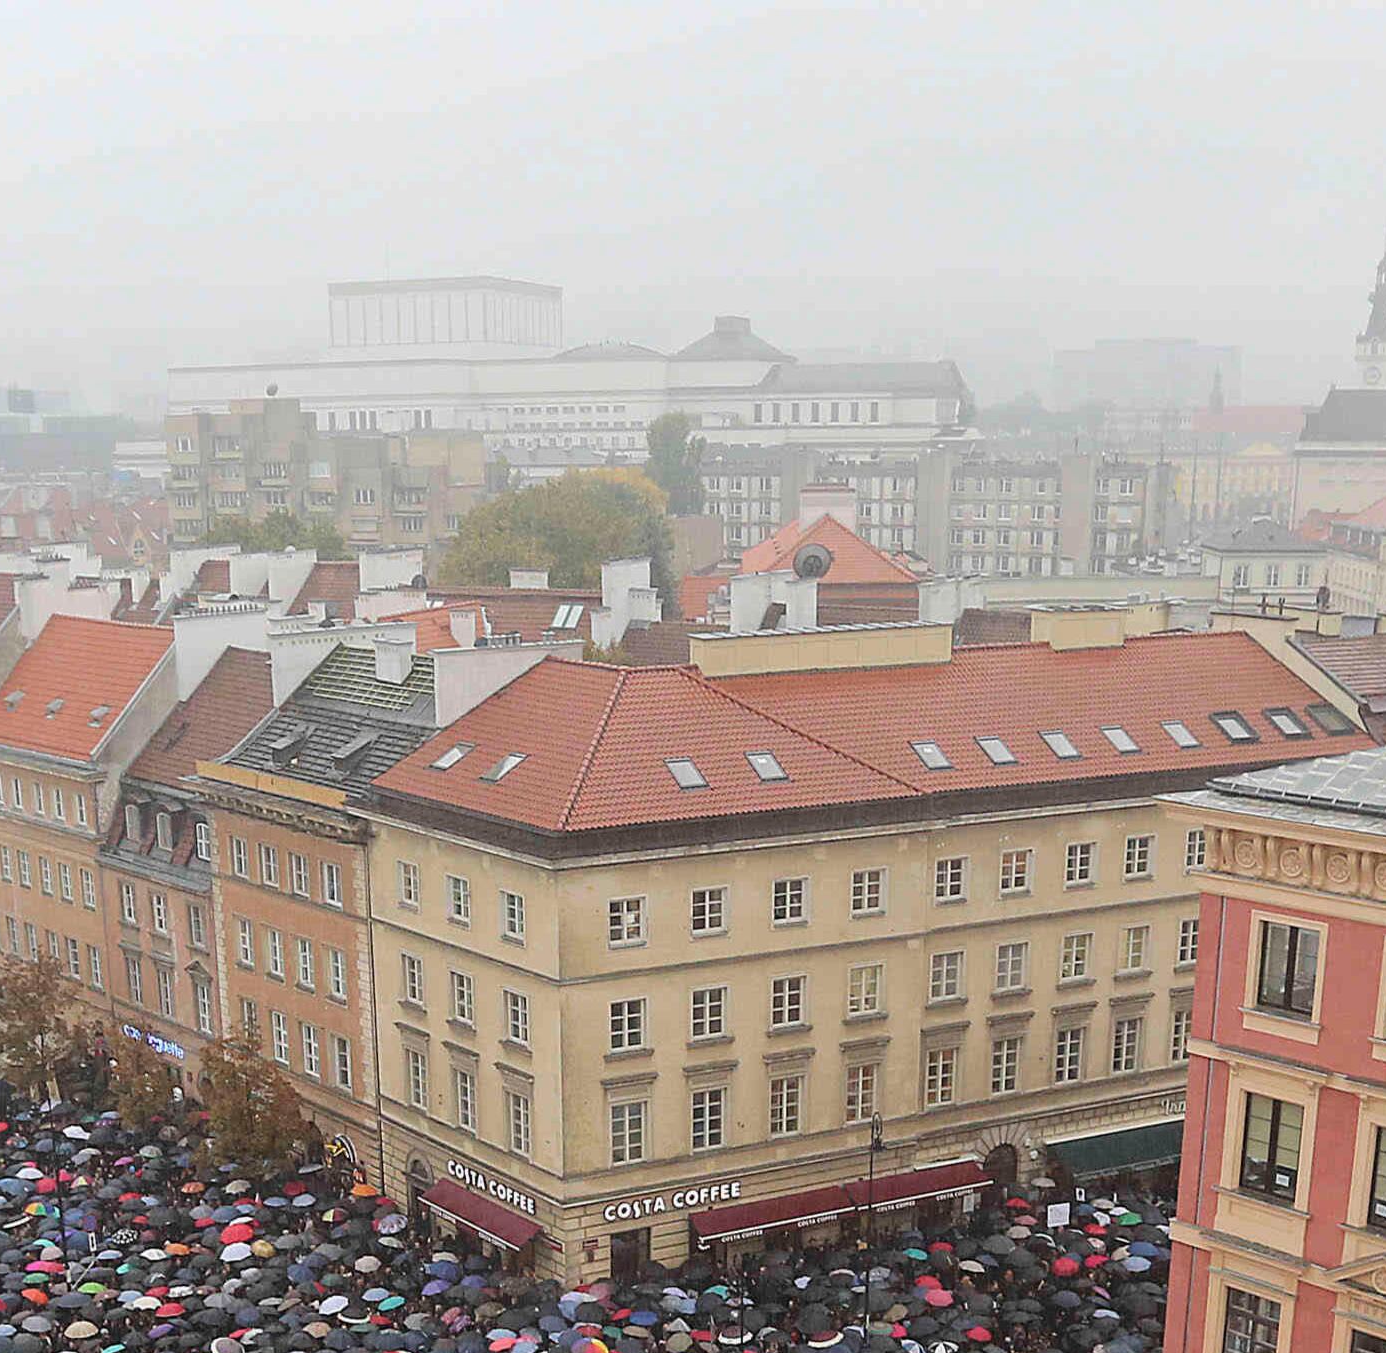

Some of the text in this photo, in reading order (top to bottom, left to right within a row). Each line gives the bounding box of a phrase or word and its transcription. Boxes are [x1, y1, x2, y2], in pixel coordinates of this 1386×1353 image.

[447, 1159, 486, 1190] COSTA
[489, 1179, 536, 1215] COFFEE
[603, 1181, 741, 1222] COSTA COFFEE
